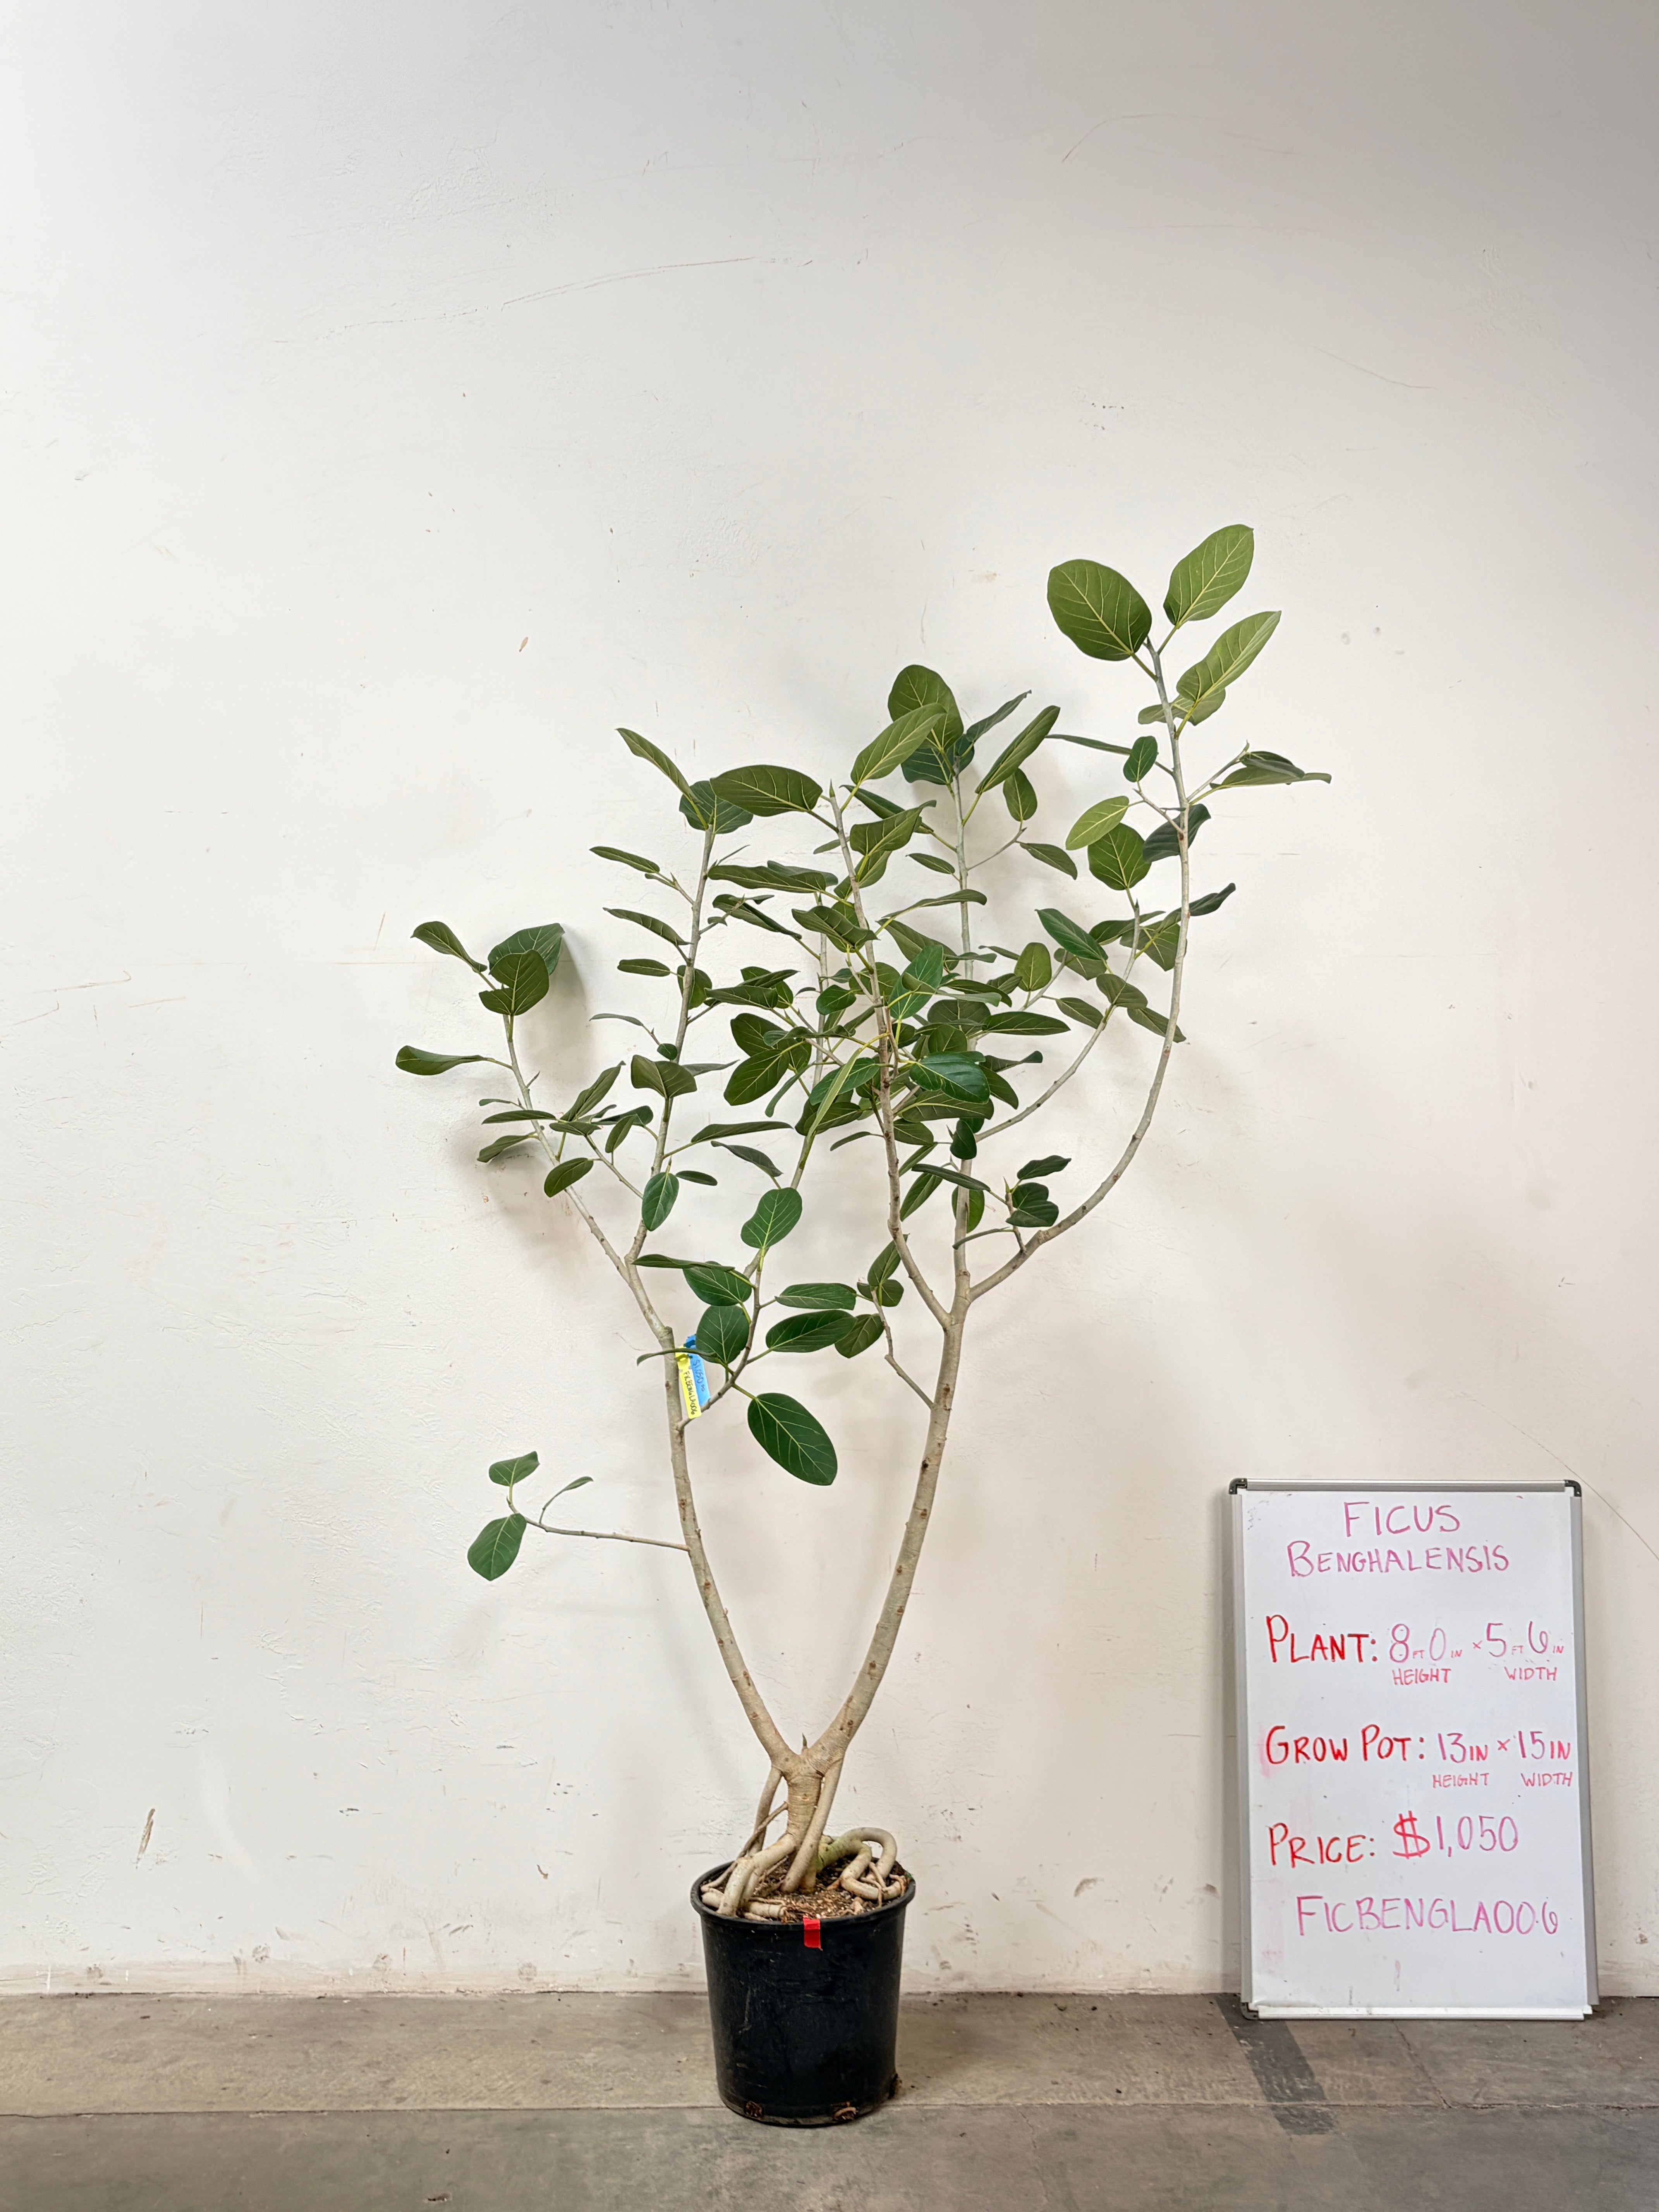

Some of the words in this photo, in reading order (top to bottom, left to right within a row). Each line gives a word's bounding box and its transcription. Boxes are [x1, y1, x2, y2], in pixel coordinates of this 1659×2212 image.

[1343, 1501, 1460, 1537] FICUS
[1287, 1540, 1509, 1577] BENGHALENSIS
[1266, 1614, 1378, 1663] PLANT:
[1391, 1668, 1452, 1685] HEIGHT
[1503, 1666, 1558, 1682] WIDTH
[1265, 1725, 1348, 1765] GROW
[1361, 1723, 1425, 1763] POT:
[1432, 1772, 1490, 1788] HEIGHT
[1520, 1771, 1573, 1788] WIDTH
[1267, 1822, 1375, 1869] PRICE:
[1392, 1810, 1519, 1860] $1,050
